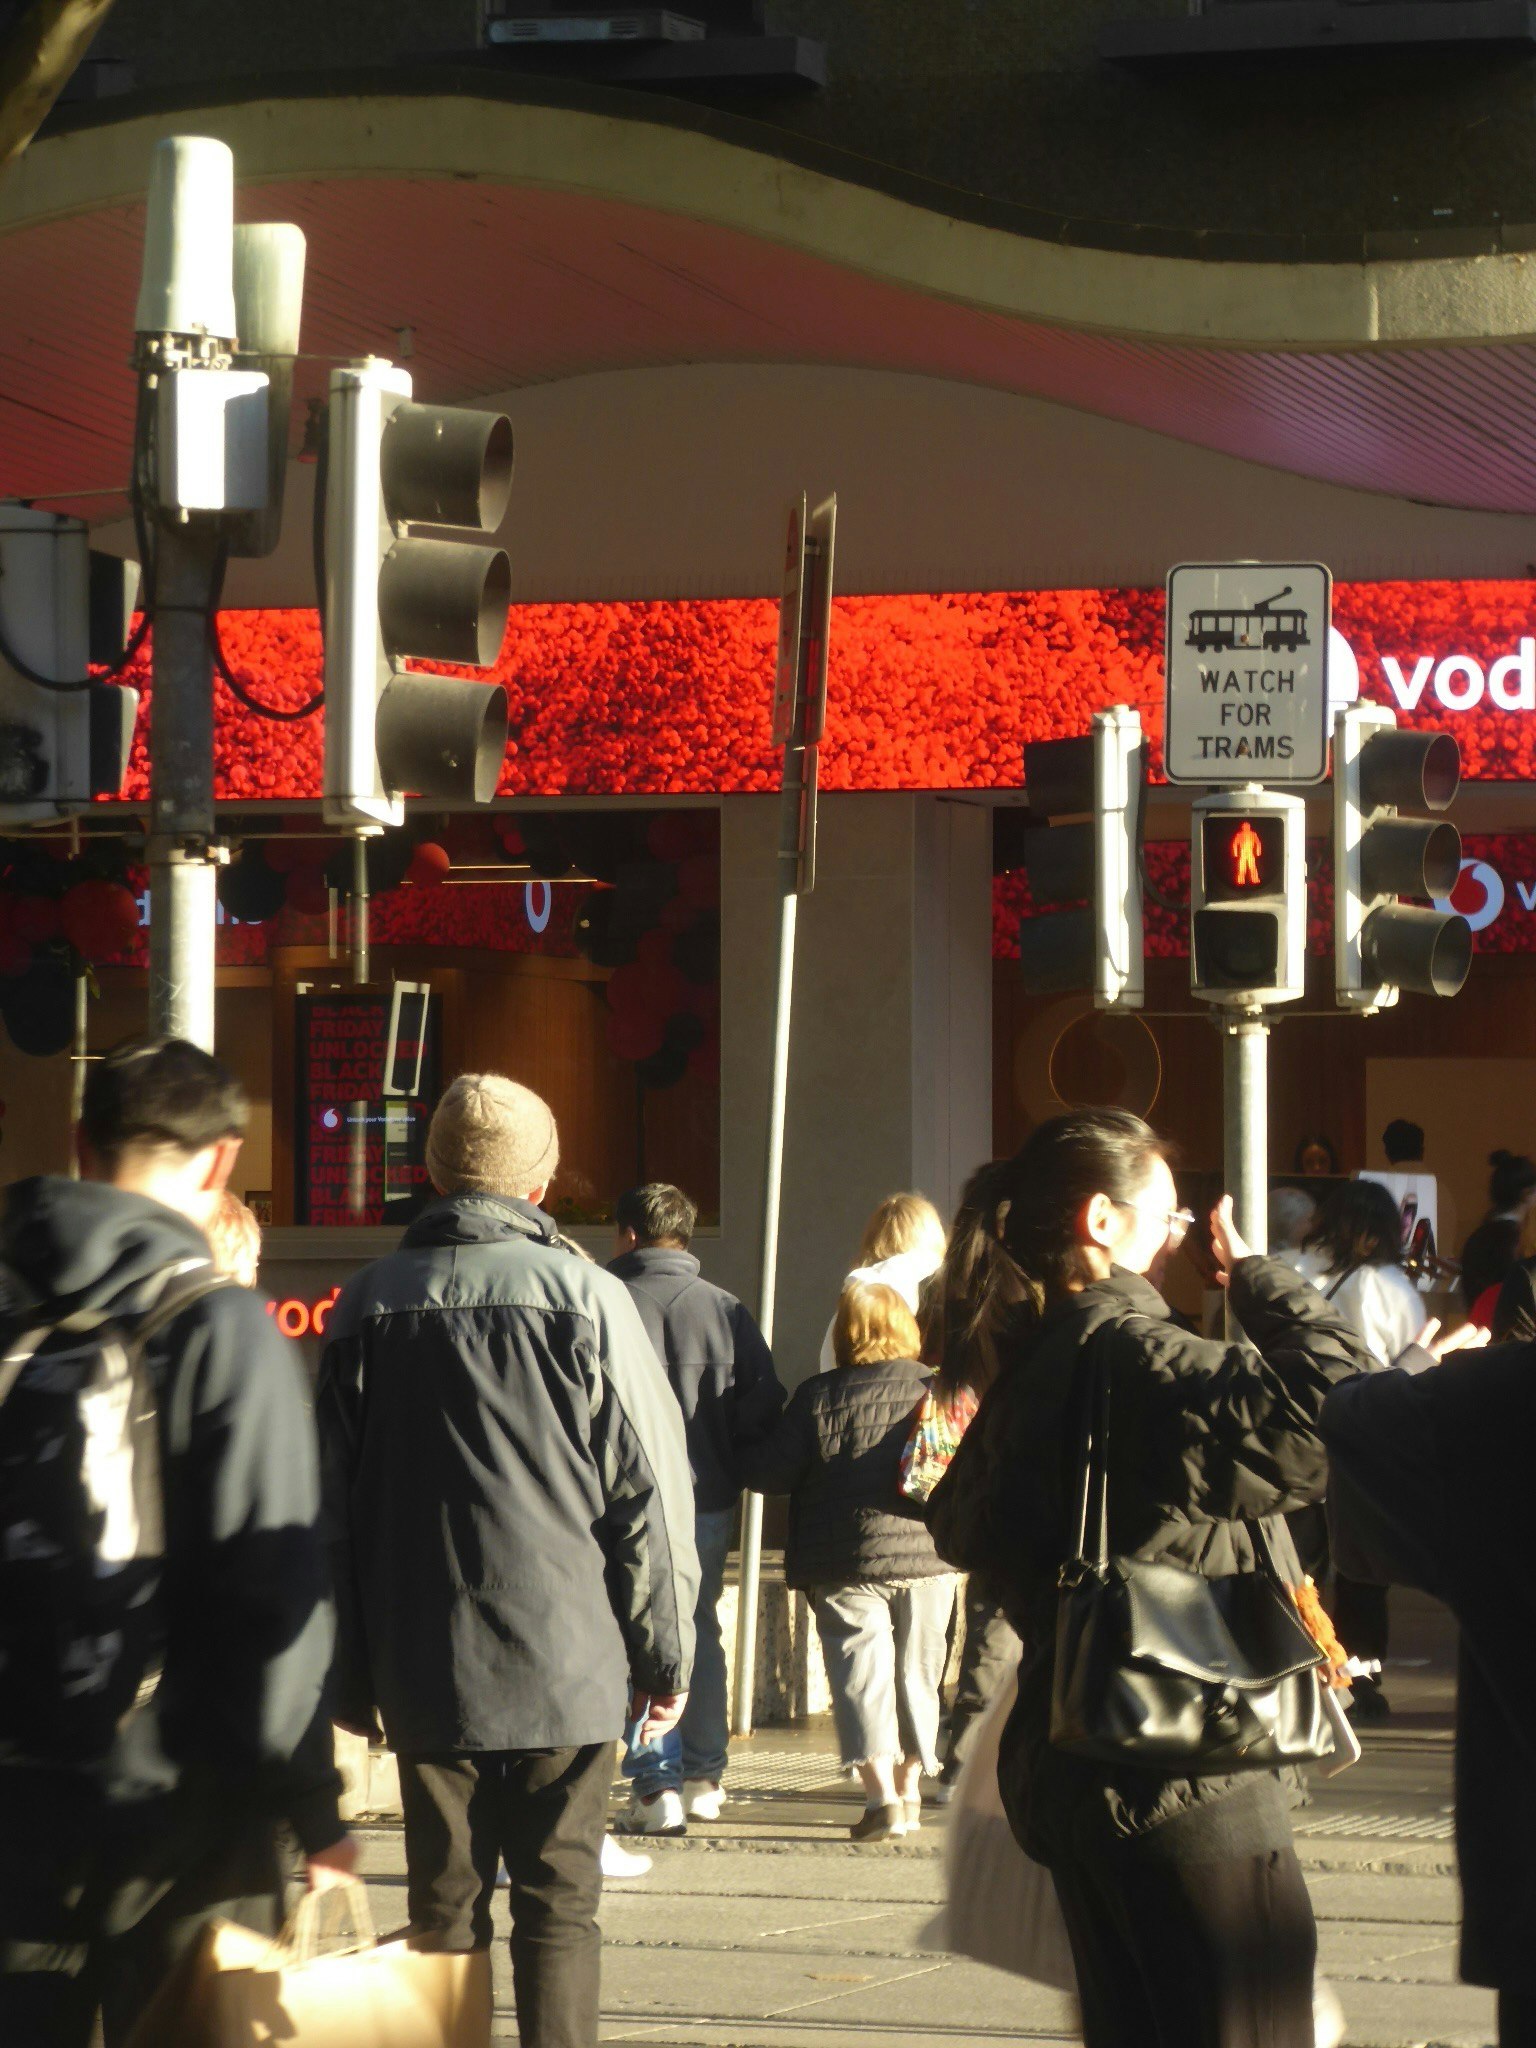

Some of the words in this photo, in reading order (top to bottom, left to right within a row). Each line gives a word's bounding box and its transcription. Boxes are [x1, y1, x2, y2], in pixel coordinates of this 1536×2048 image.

[1199, 669, 1295, 694] WATCH
[1381, 636, 1536, 711] vod
[1220, 702, 1272, 727] FOR
[1197, 735, 1295, 760] TRAMS
[309, 1020, 384, 1039] FRIDAY
[309, 1061, 383, 1080] BLACK
[309, 1082, 384, 1101] FRIDAY
[309, 1208, 384, 1226] FRIDAY
